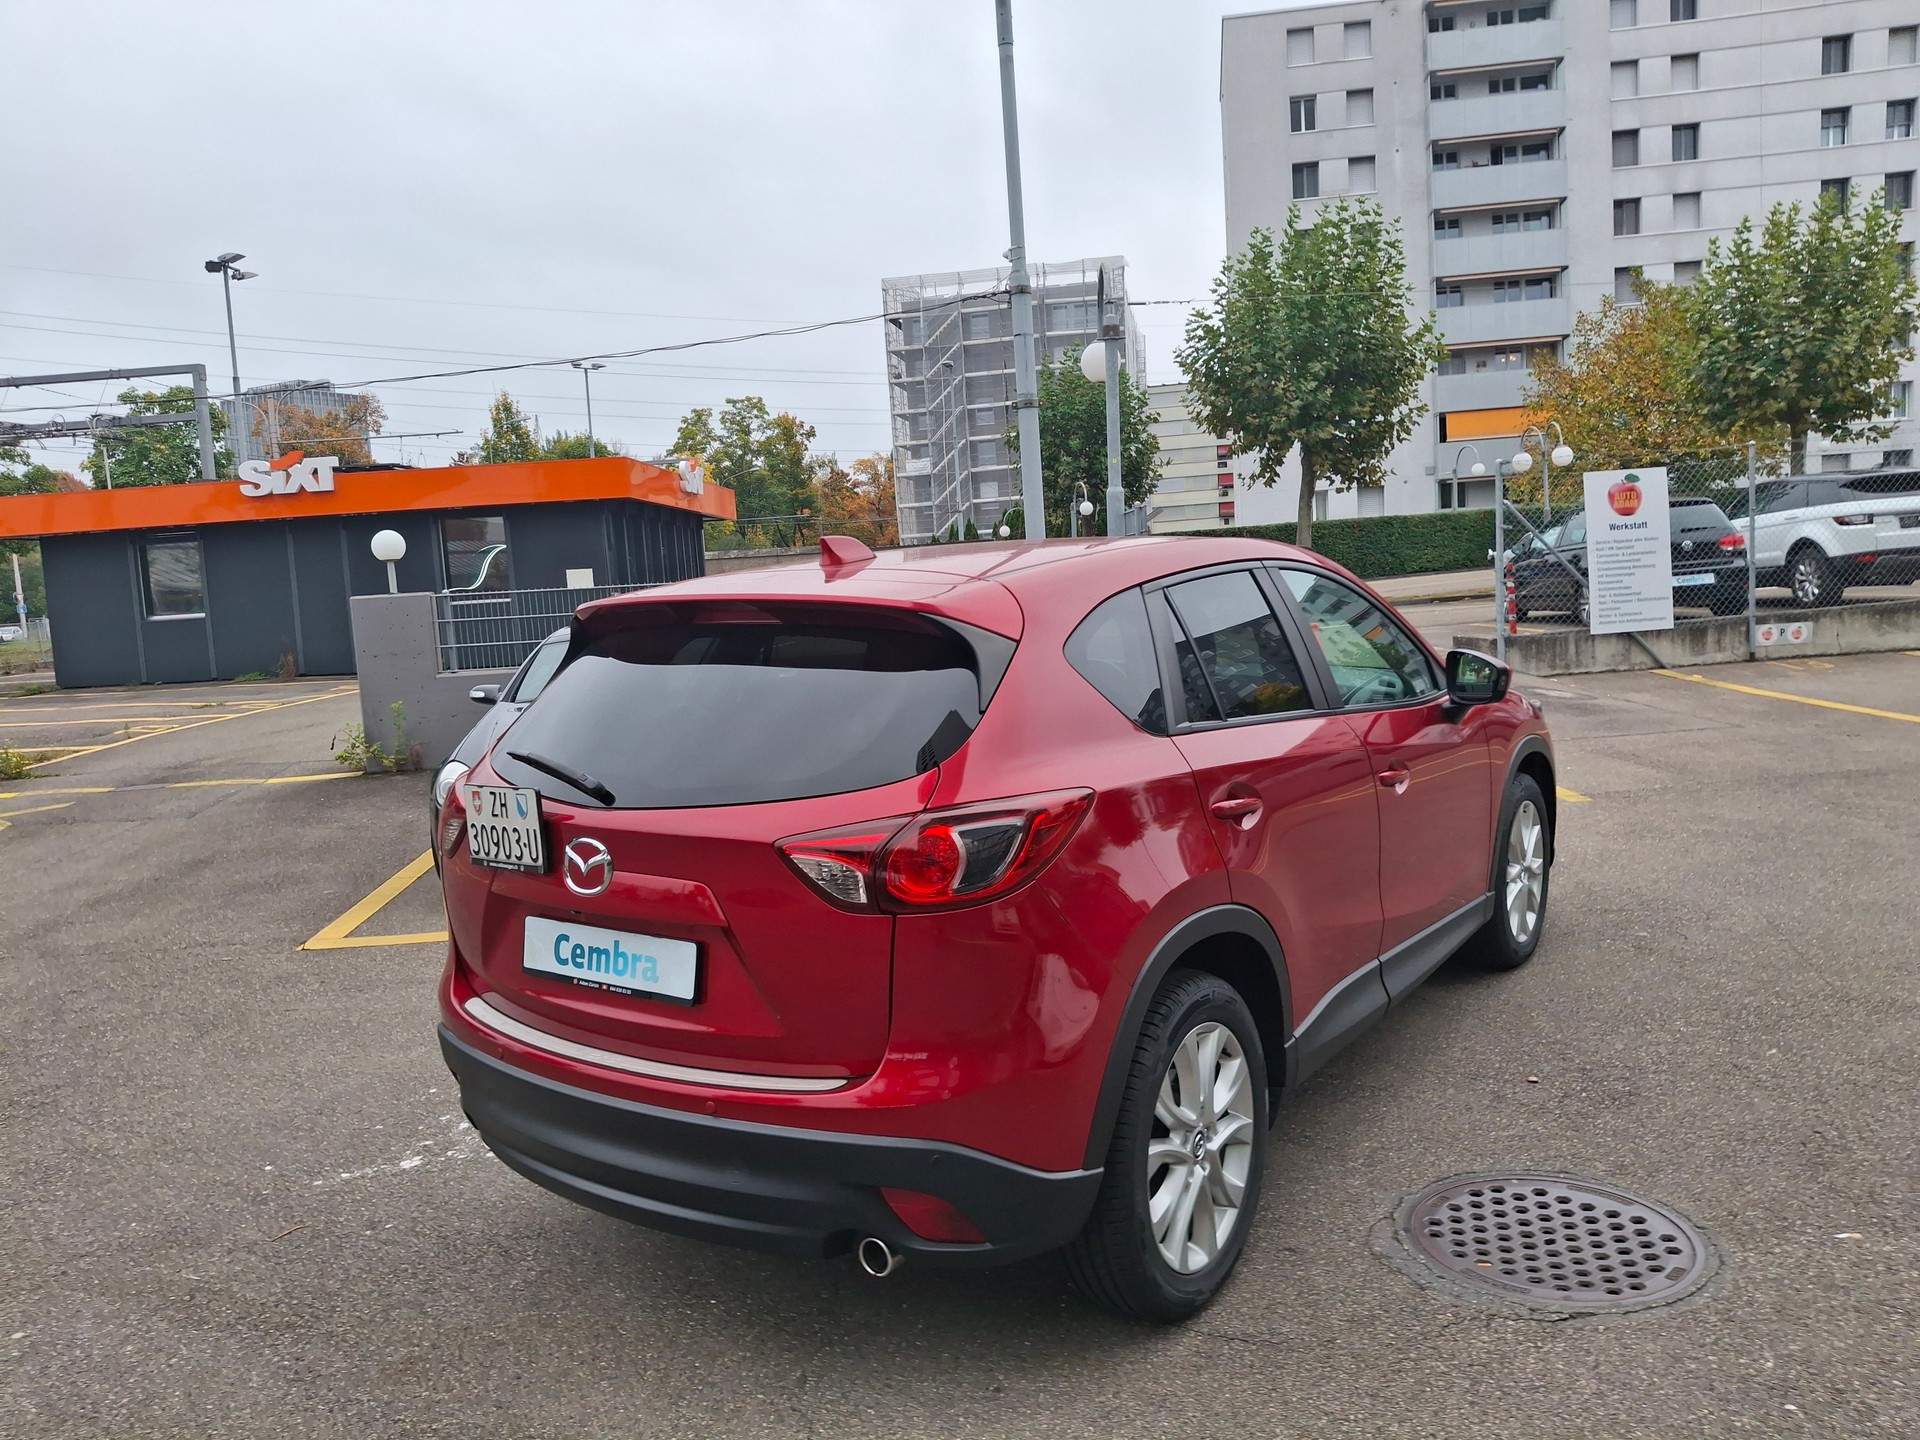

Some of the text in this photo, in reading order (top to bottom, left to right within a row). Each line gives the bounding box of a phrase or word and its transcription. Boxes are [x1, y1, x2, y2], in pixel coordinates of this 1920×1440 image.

[1614, 491, 1637, 500] AUTO
[1613, 499, 1638, 508] ADAM
[1609, 521, 1648, 531] Werkstatt
[1780, 628, 1786, 637] P
[489, 791, 508, 819] ZH
[553, 933, 660, 984] Cembra
